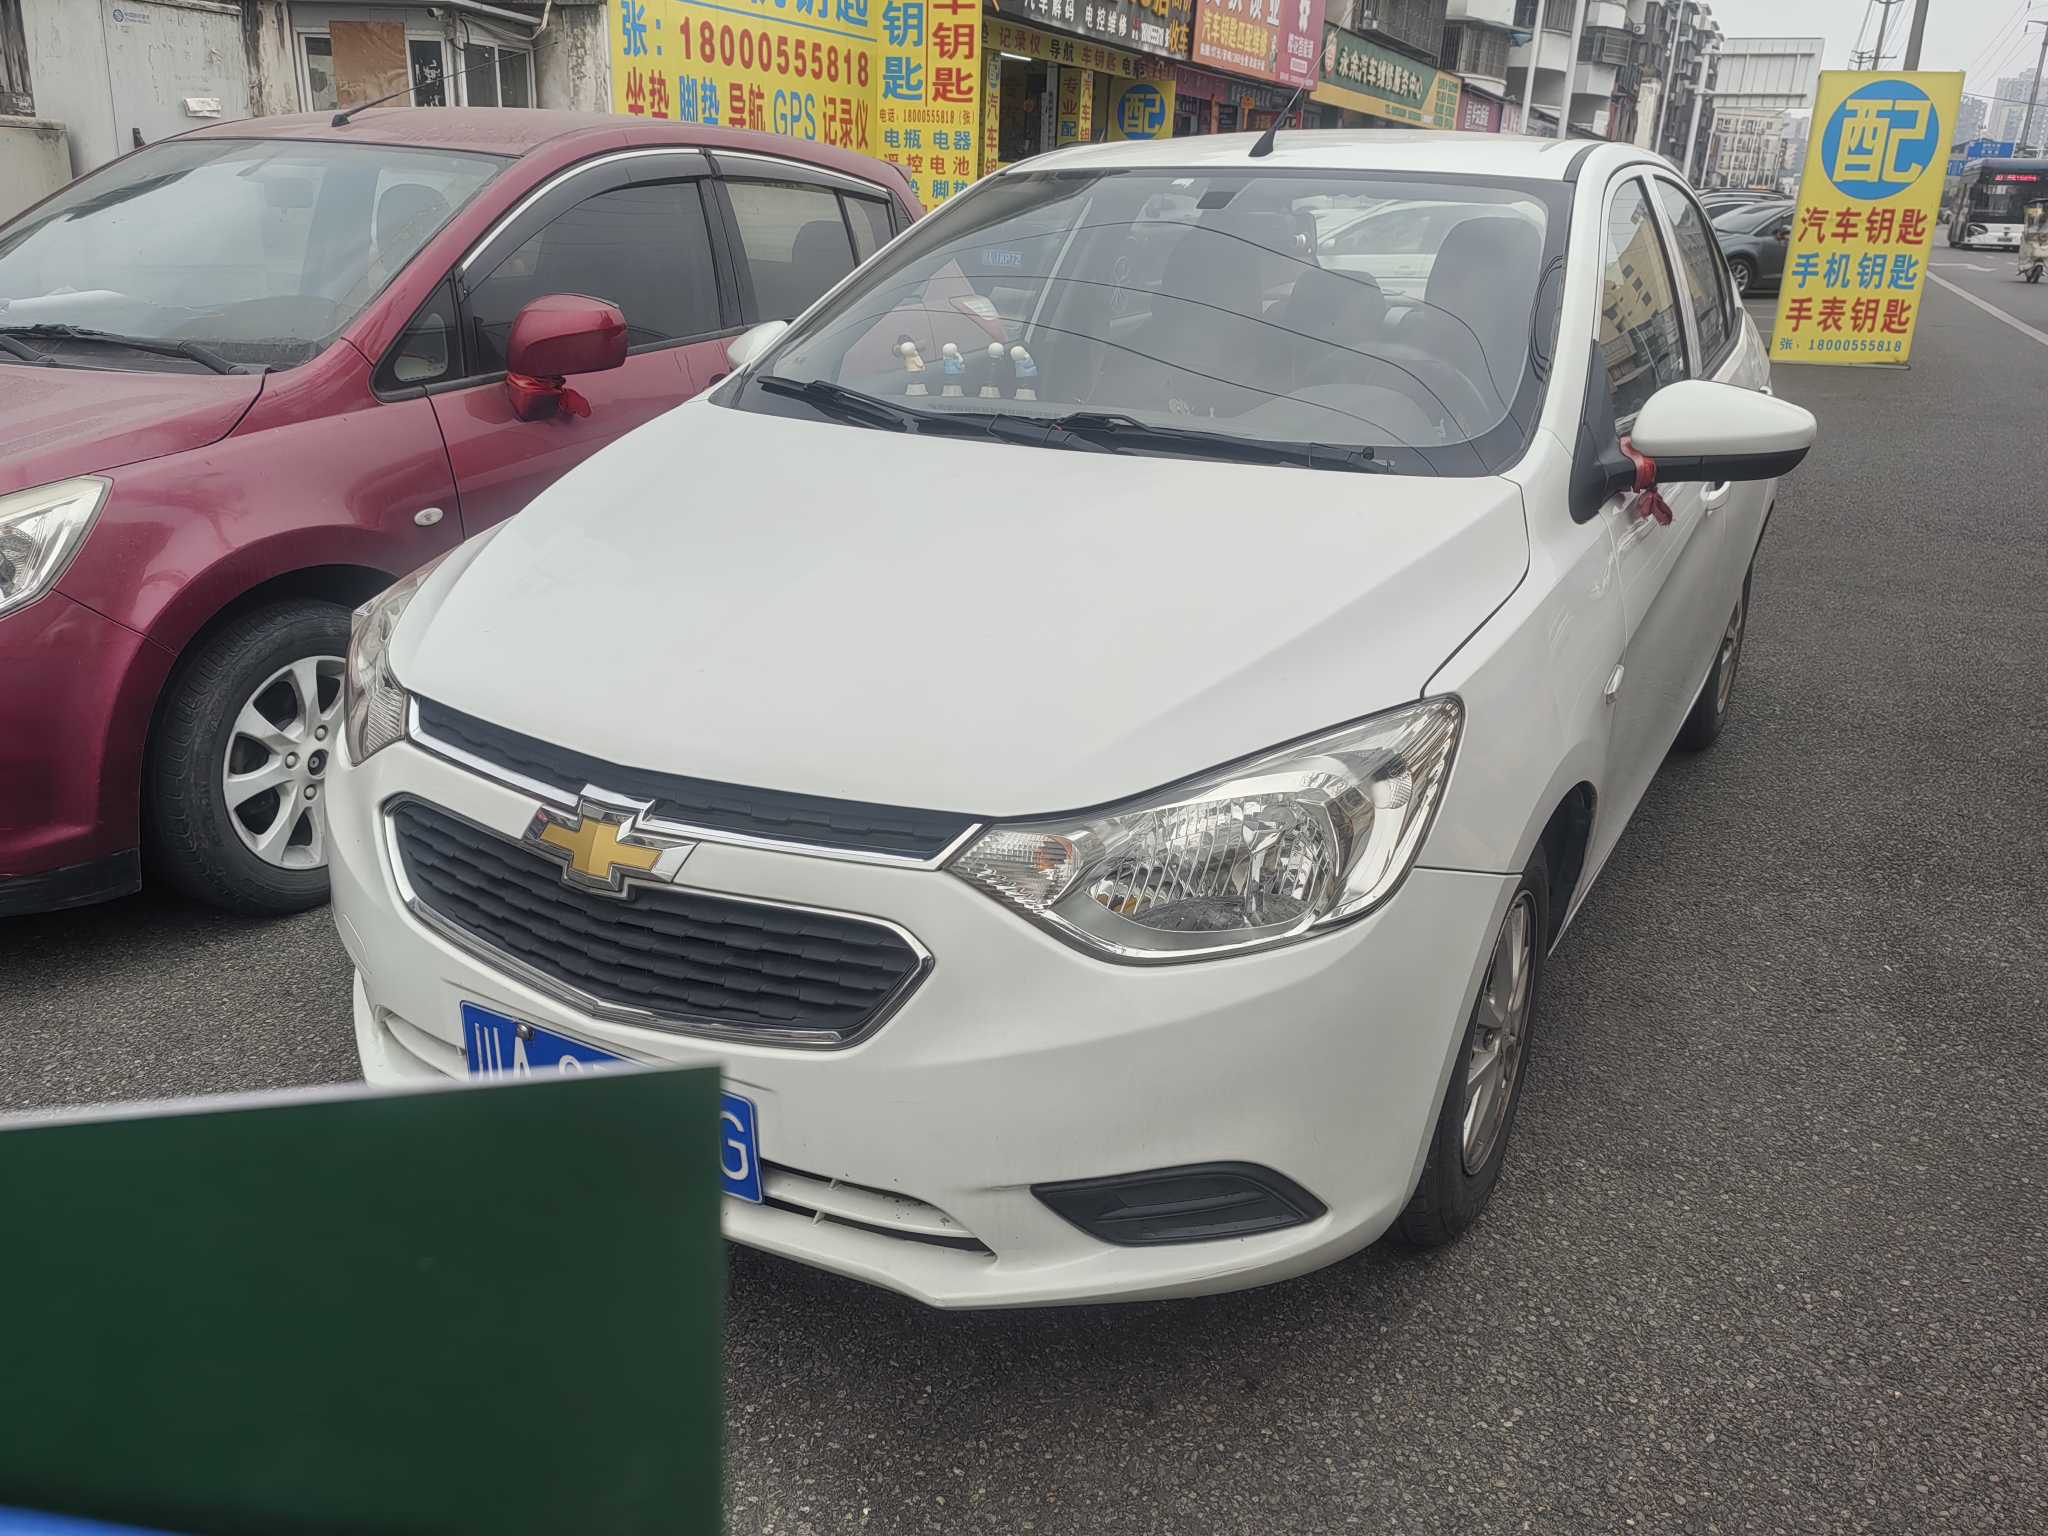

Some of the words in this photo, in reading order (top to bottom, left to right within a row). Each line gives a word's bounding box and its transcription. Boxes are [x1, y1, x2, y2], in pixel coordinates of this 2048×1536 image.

[1085, 3, 1128, 37] 电控维修
[680, 16, 869, 88] 18000555818
[626, 66, 670, 119] 坐垫
[679, 75, 720, 126] 脚垫
[728, 82, 766, 132] 导航
[773, 89, 816, 141] GPS
[823, 95, 869, 150] 记录仪
[903, 109, 955, 124] 18000555818
[1122, 92, 1165, 134] 配
[884, 128, 922, 149] 电瓶
[933, 130, 972, 150] 电器
[1833, 98, 1933, 184] 配
[1797, 207, 1929, 246] 汽车钥匙
[1791, 252, 1920, 291] 手机钥匙
[1785, 296, 1913, 334] 手表钥匙
[1808, 338, 1903, 352] 18000555818
